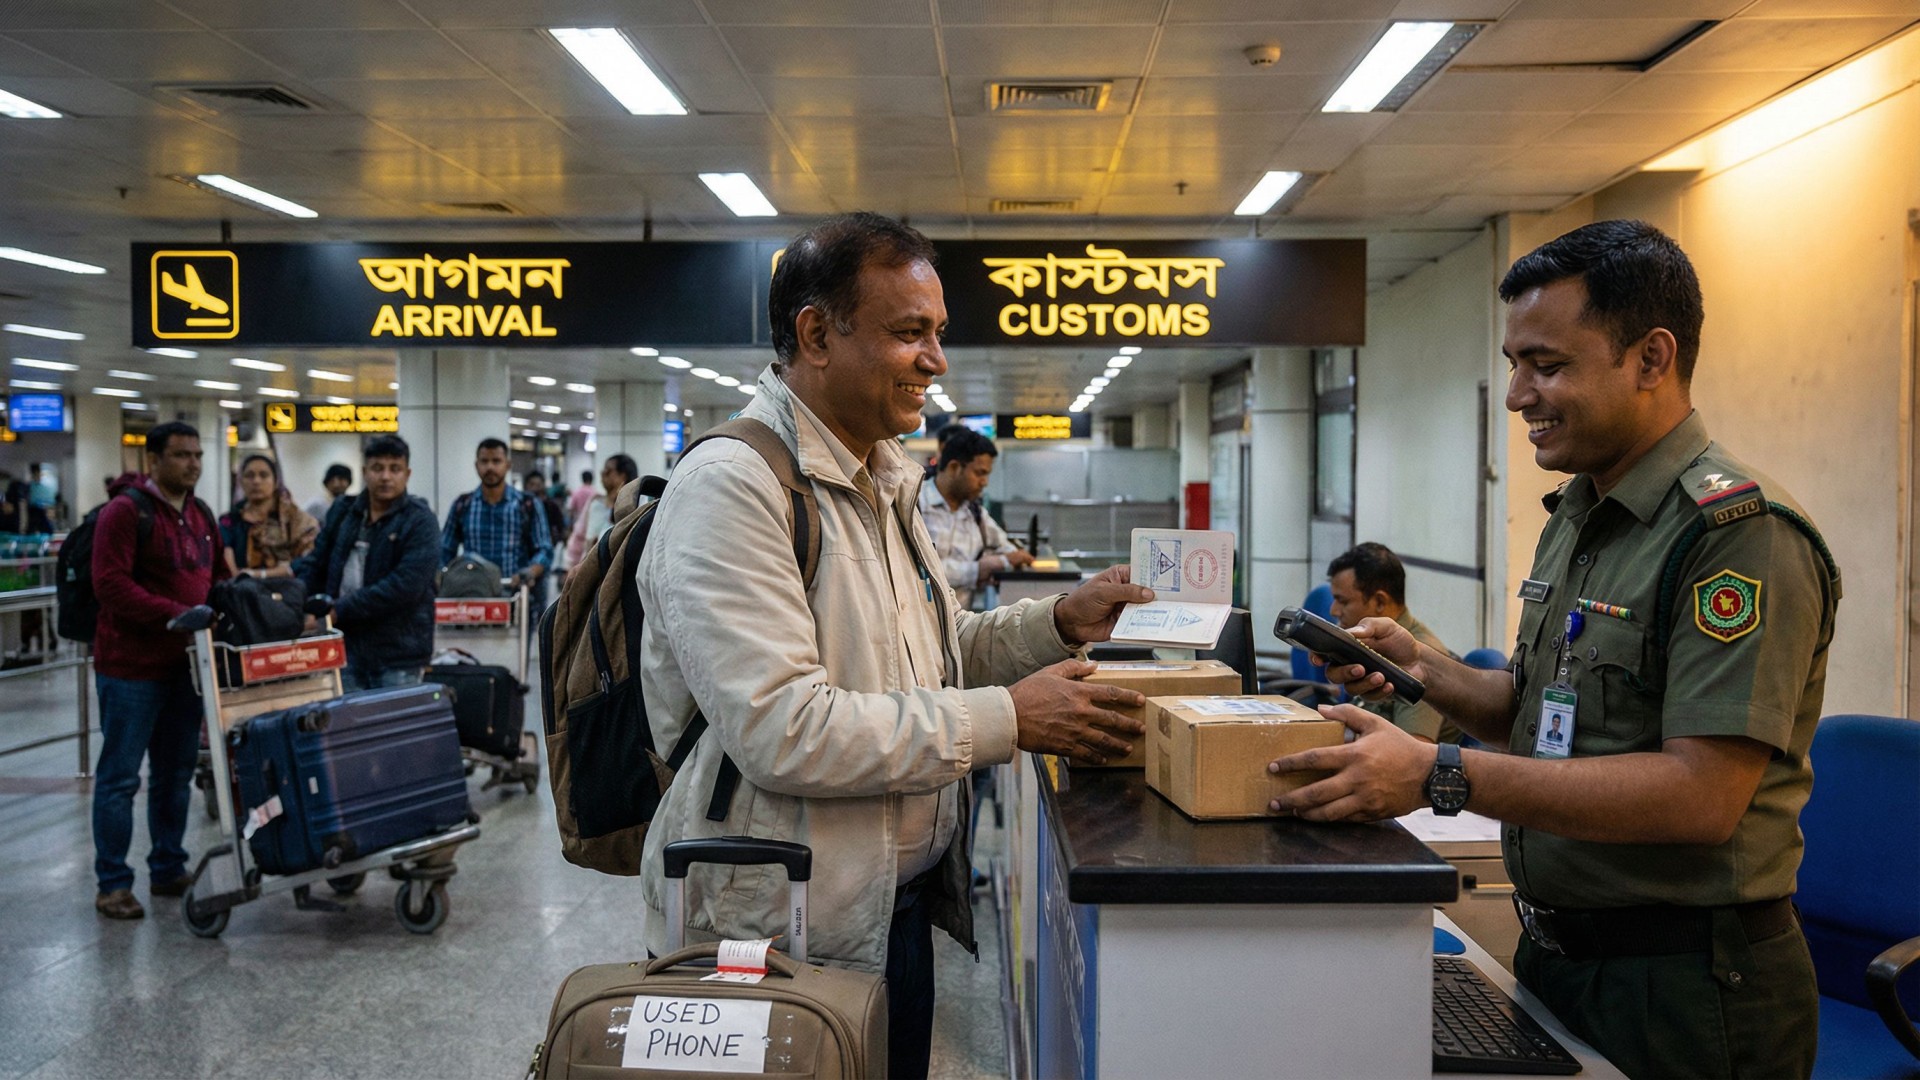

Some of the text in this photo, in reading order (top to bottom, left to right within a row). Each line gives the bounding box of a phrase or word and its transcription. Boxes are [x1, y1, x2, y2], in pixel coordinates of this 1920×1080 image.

[358, 252, 571, 299] আগমন
[982, 243, 1226, 299] কাস্টমস
[370, 304, 557, 337] ARRIVAL
[998, 303, 1211, 337] CUSTOMS
[644, 1000, 720, 1025] USED
[646, 1028, 744, 1059] PHONE
